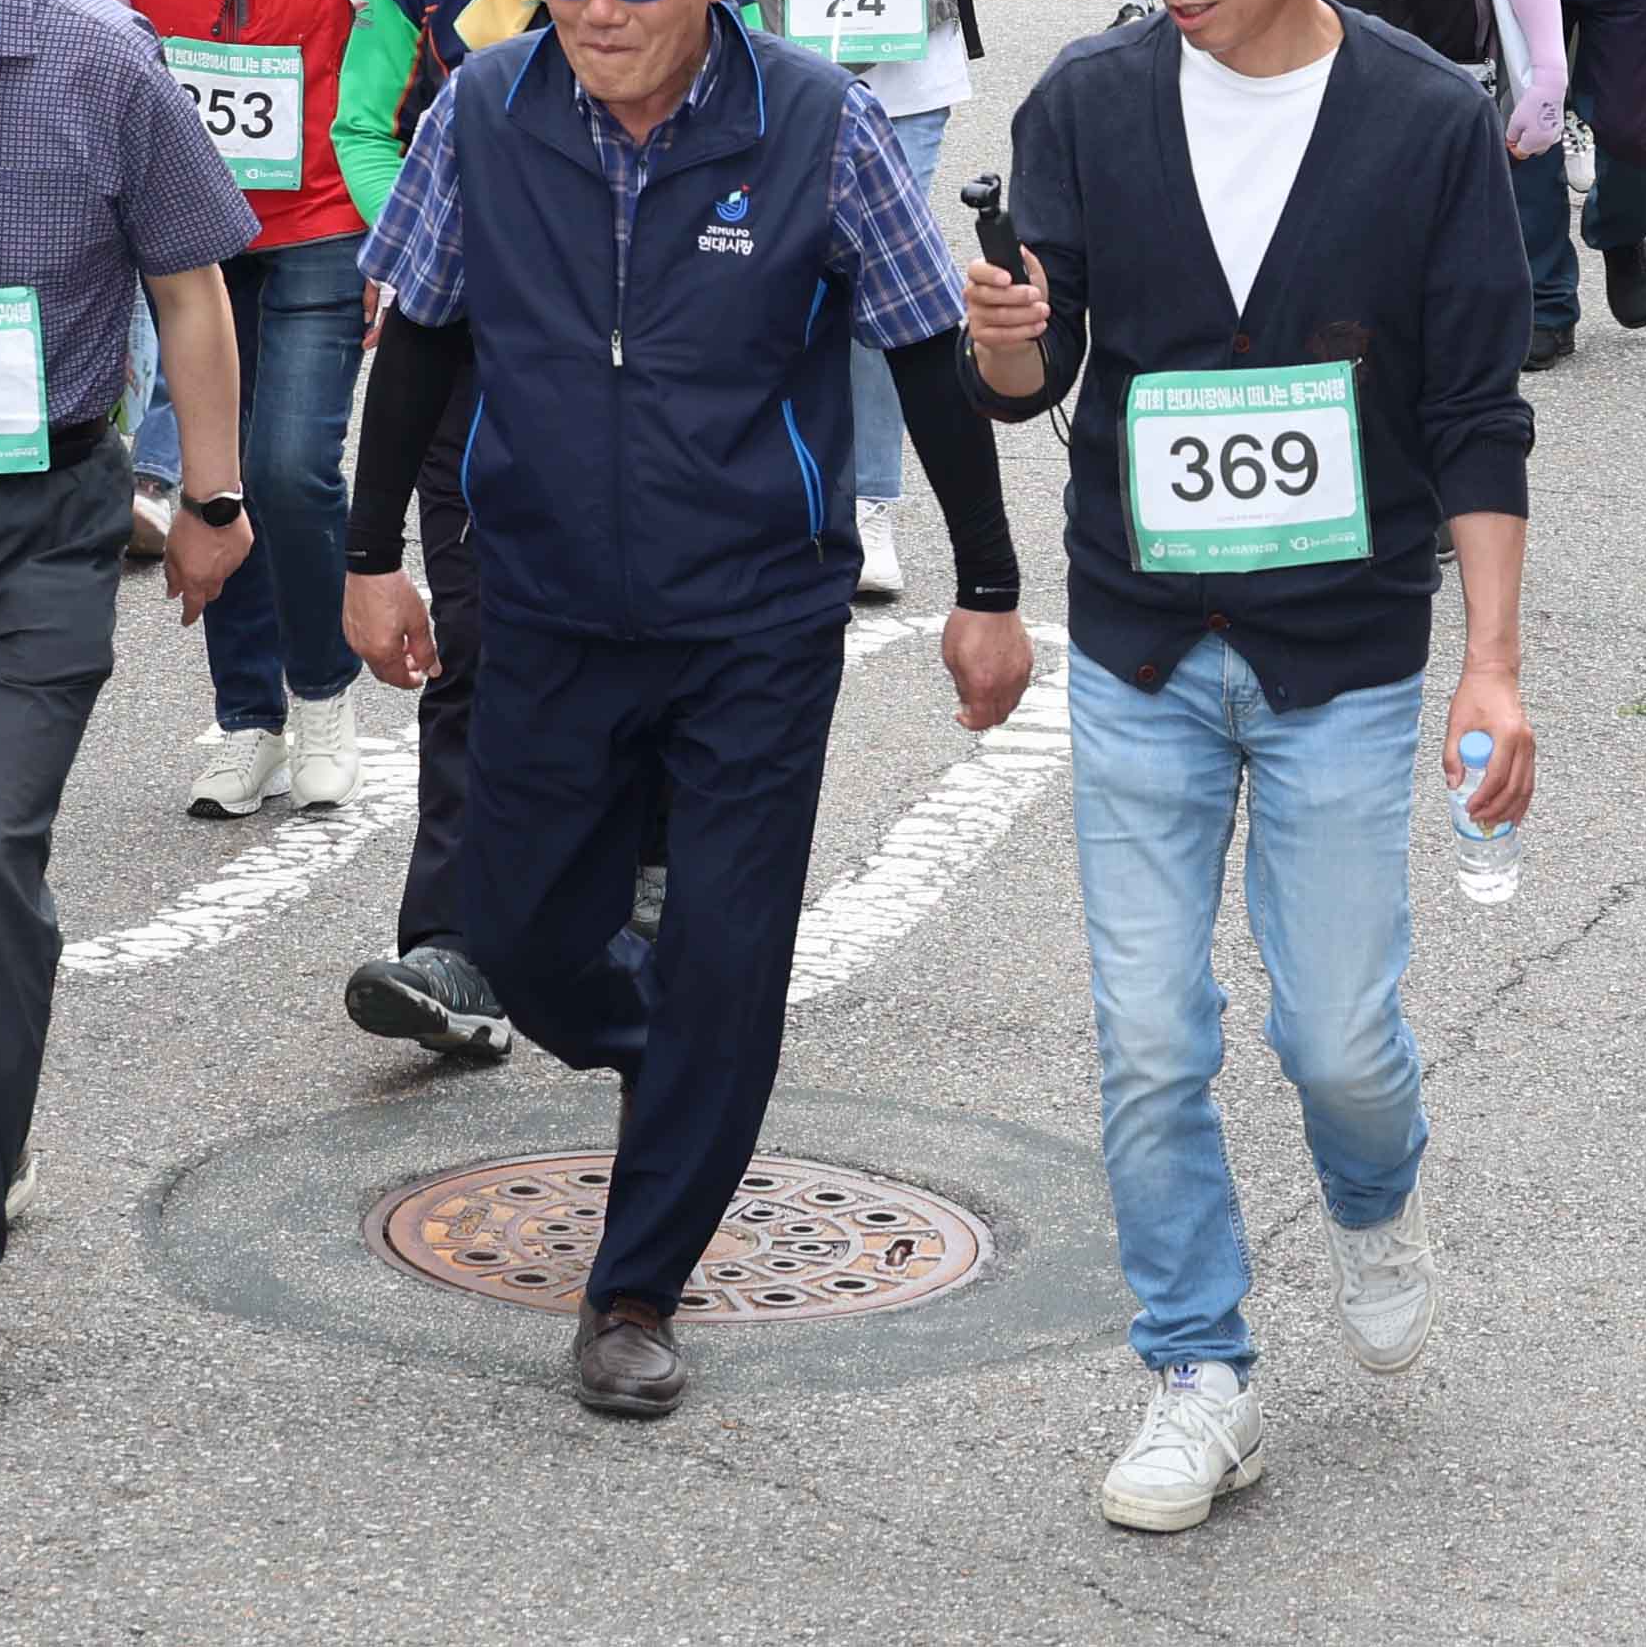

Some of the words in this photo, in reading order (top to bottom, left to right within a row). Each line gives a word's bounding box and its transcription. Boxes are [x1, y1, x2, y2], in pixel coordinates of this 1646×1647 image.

[1247, 383, 1289, 407] 떠나는
[1290, 377, 1346, 404] 동구여행
[1169, 430, 1319, 502] 369
